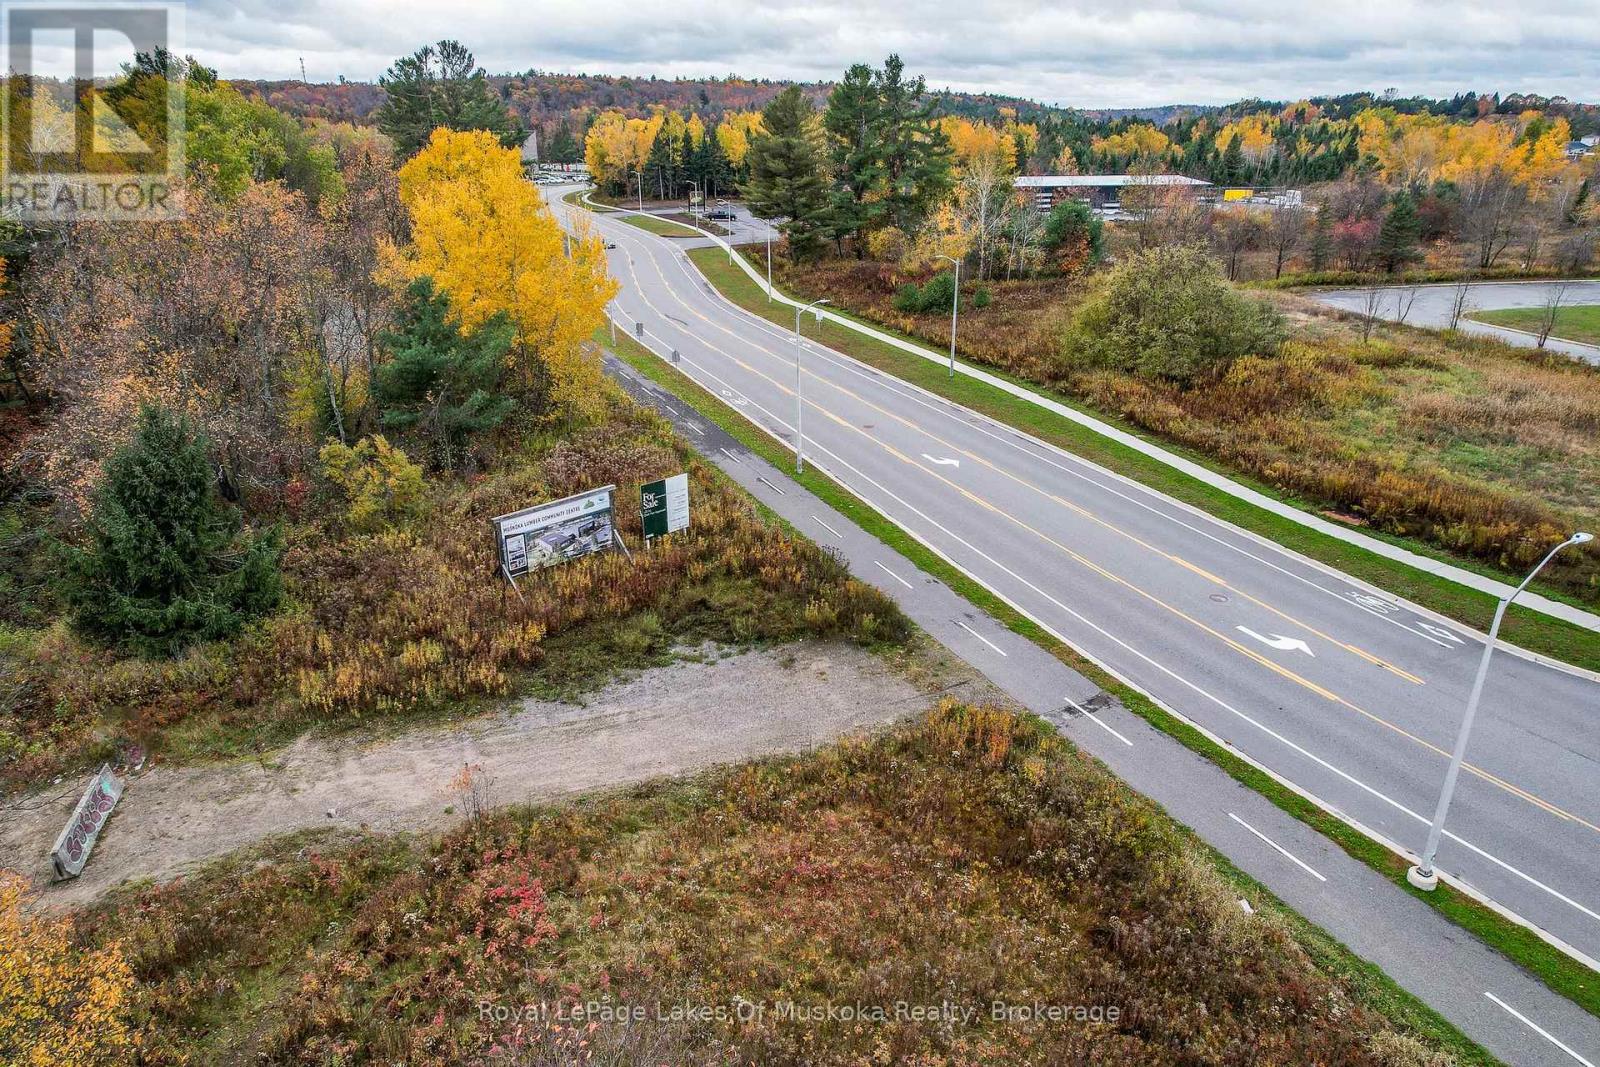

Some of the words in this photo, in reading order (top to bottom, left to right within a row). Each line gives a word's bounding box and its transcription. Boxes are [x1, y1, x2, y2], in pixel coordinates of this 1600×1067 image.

[643, 493, 655, 501] For
[643, 500, 658, 509] Sale
[541, 511, 565, 522] COMMUNITY
